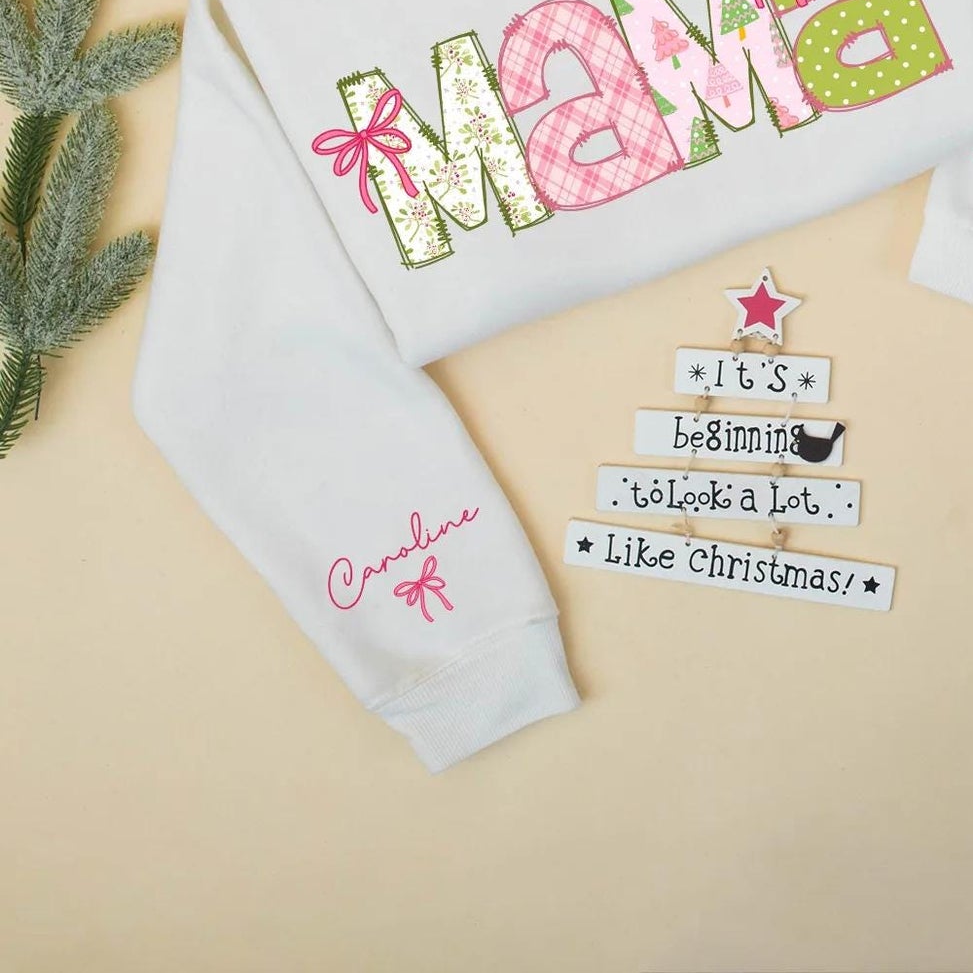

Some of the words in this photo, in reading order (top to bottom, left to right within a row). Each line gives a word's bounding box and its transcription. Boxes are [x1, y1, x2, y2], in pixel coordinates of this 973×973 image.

[672, 416, 805, 455] beginning
[740, 488, 758, 513] a
[770, 485, 820, 515] Lot
[328, 507, 480, 610] Caroline
[604, 533, 676, 569] Like
